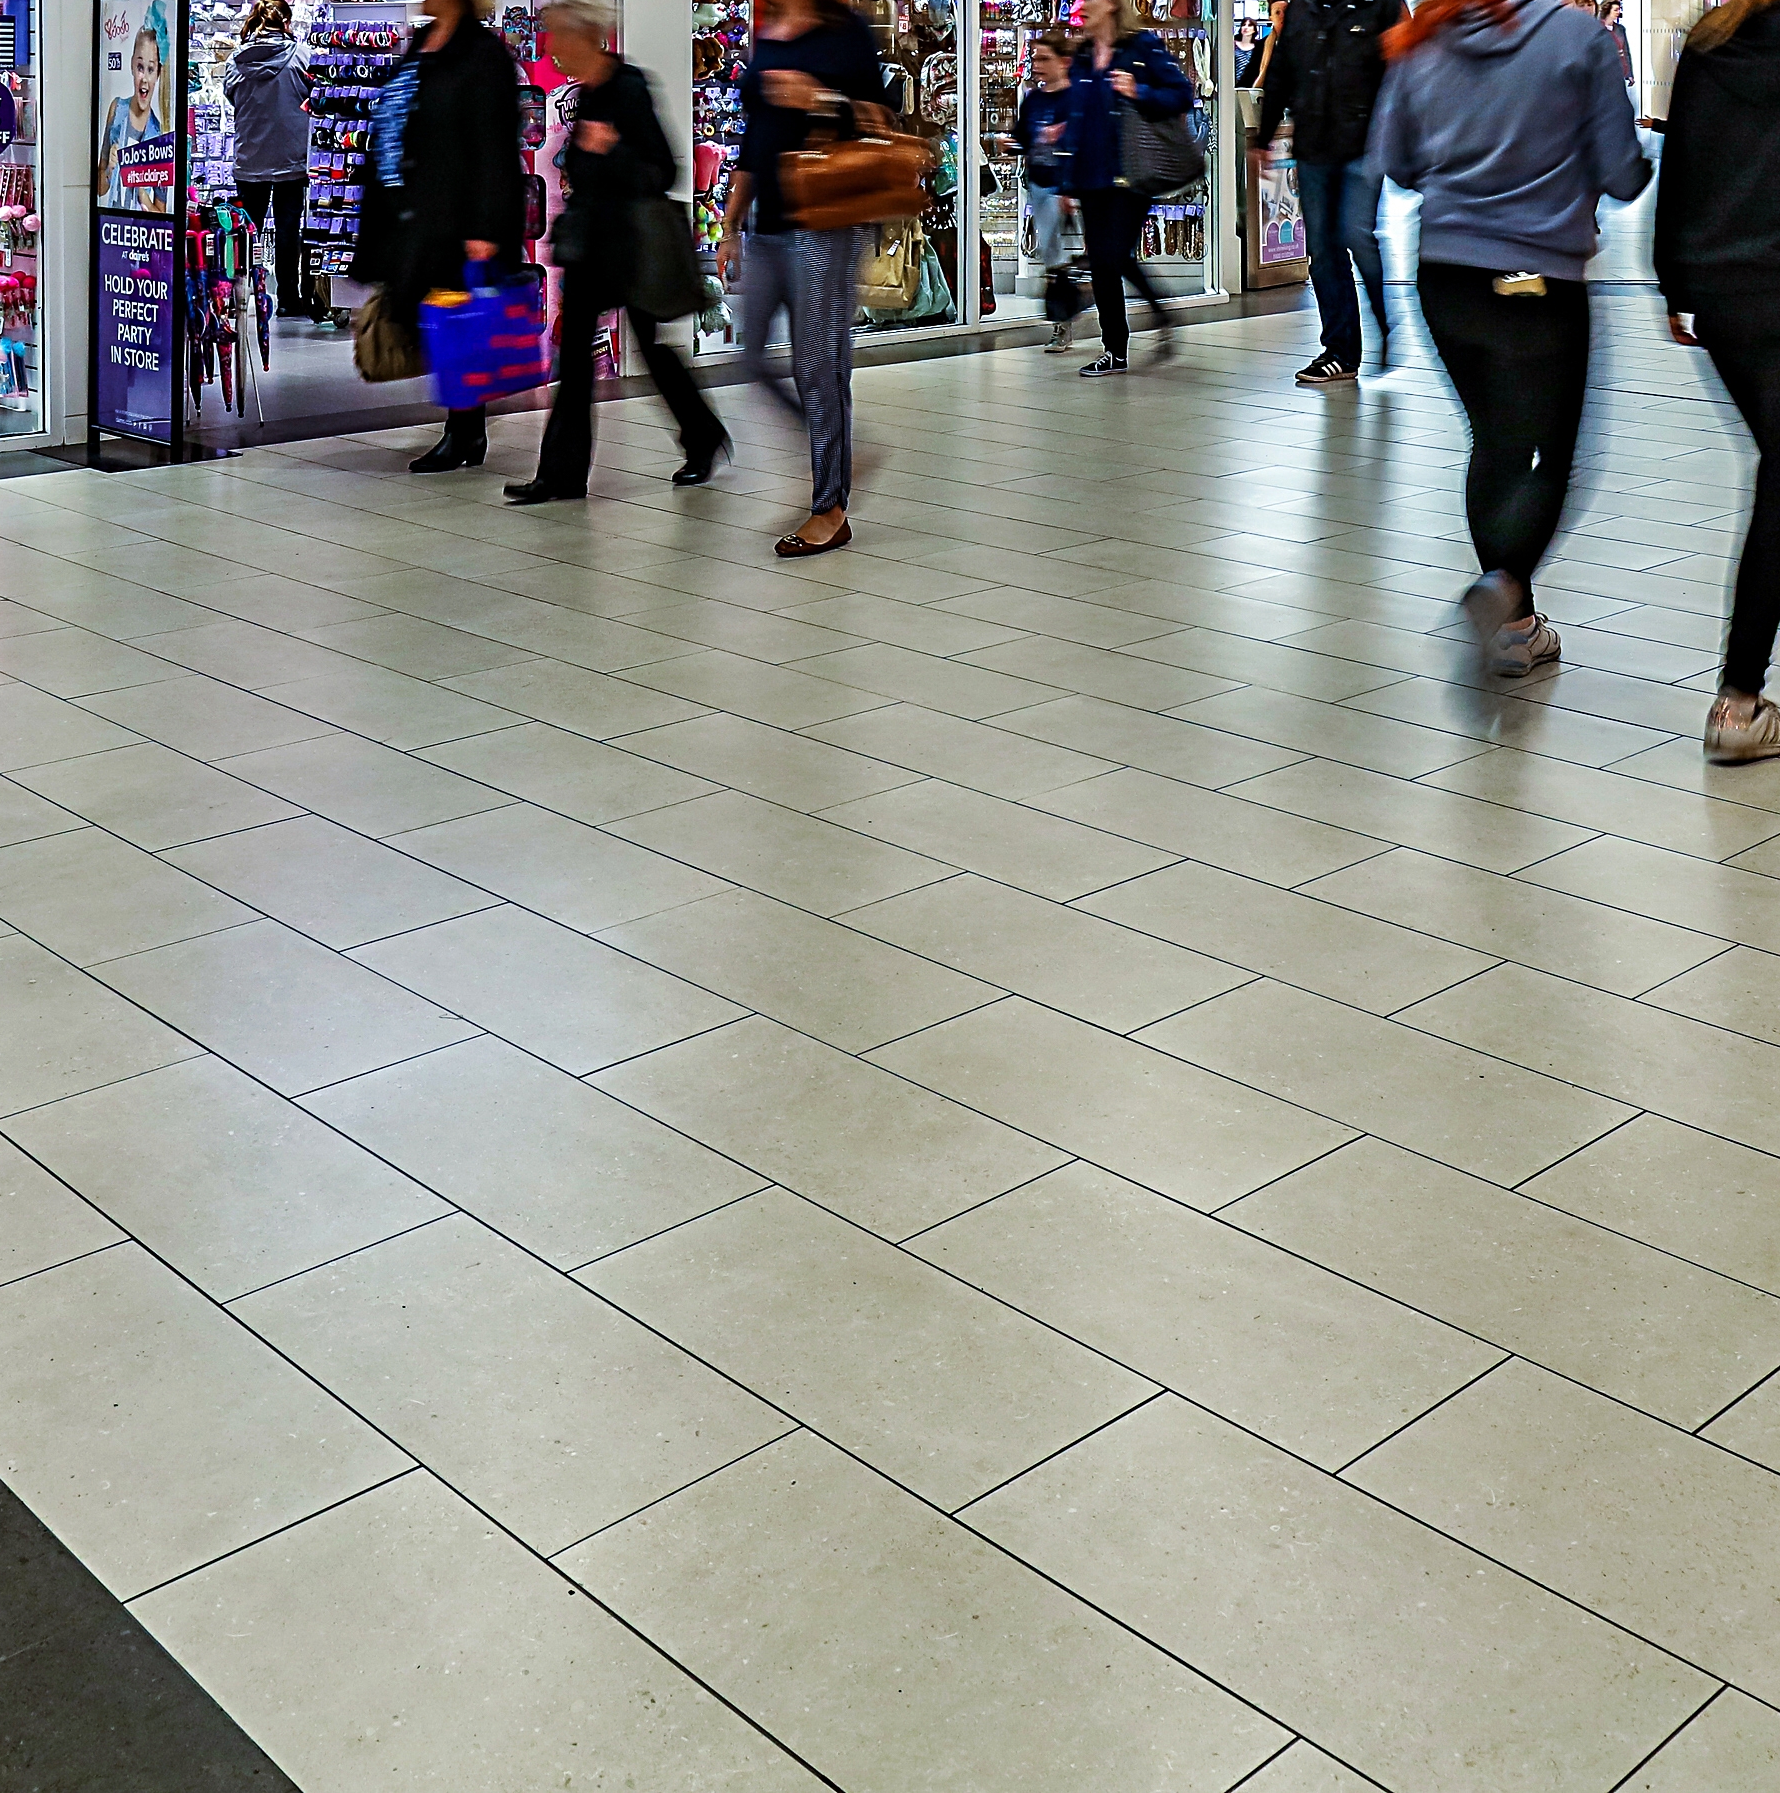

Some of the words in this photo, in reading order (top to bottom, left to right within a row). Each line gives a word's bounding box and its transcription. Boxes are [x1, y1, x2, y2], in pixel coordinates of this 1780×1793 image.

[120, 147, 147, 167] JoJo's
[101, 222, 173, 252] CELEBRATE
[121, 251, 129, 259] AT
[128, 249, 150, 263] claire's
[104, 274, 135, 295] HOLD
[136, 278, 168, 300] YOUR
[112, 298, 159, 323] PERFECT
[117, 322, 152, 346] PARTY
[110, 345, 122, 364] IN
[123, 349, 160, 372] STORE
